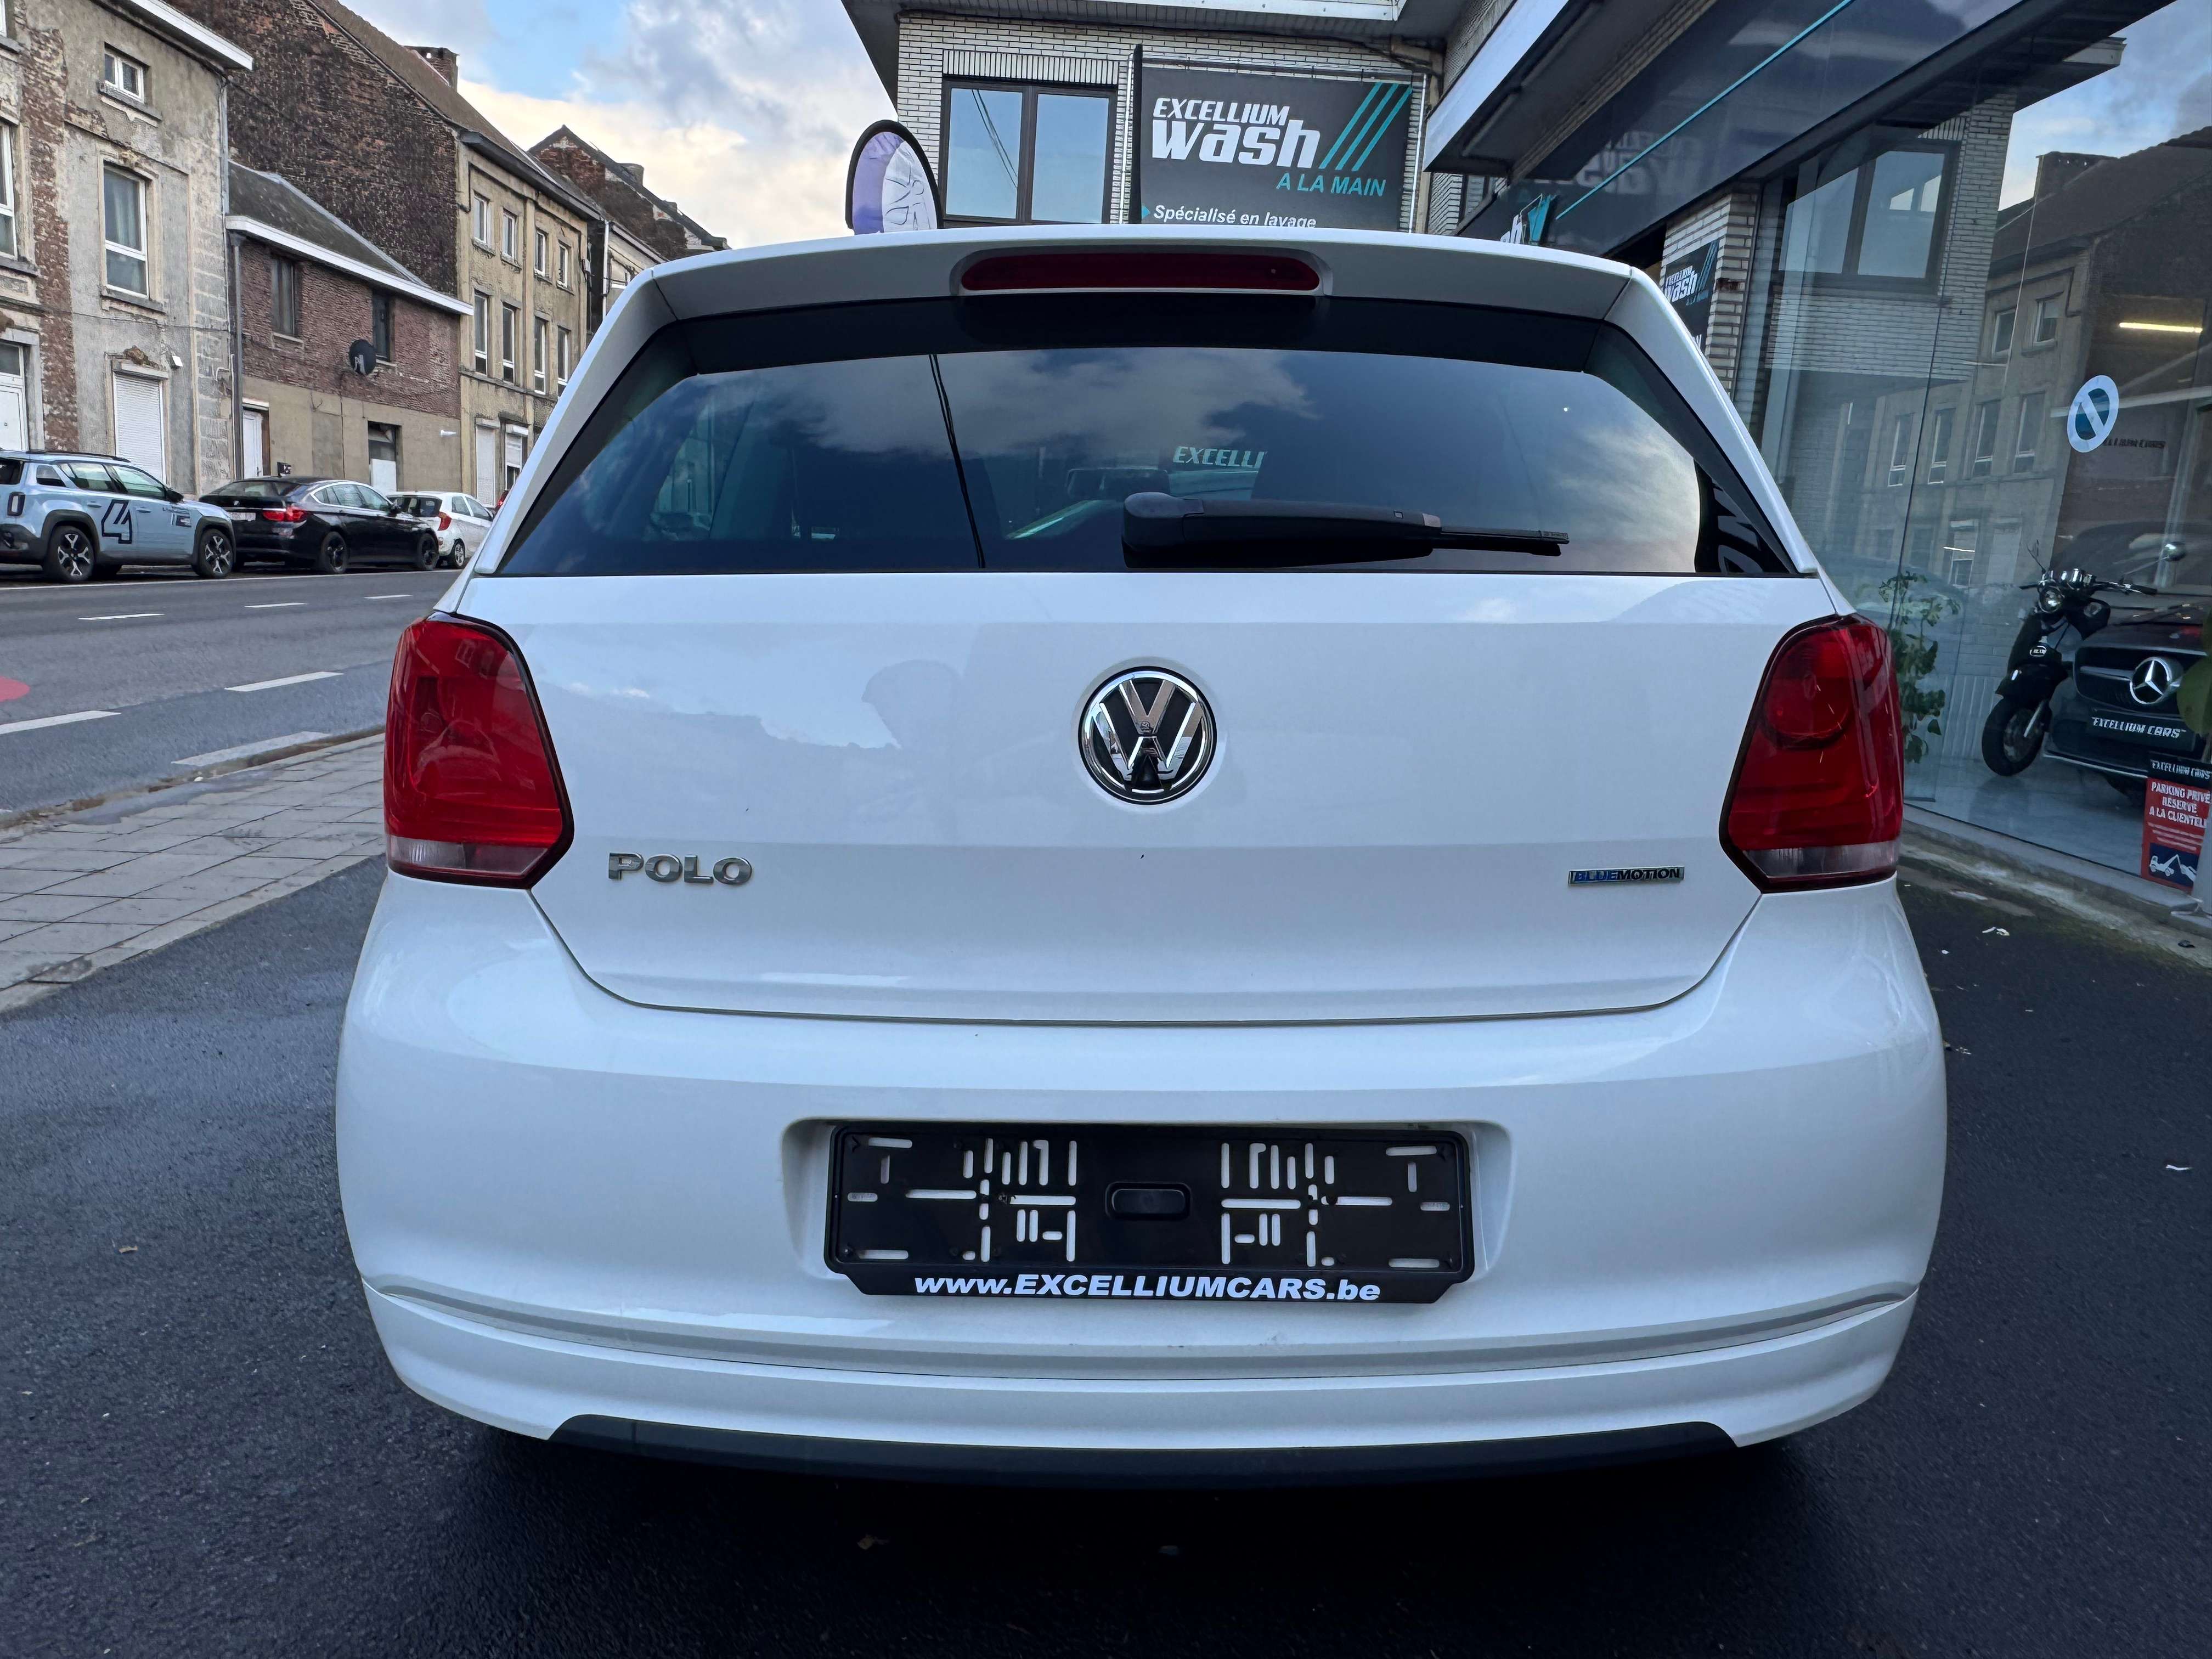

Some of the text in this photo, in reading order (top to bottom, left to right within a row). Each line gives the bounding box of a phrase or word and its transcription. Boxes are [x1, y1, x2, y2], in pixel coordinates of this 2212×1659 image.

[1153, 98, 1290, 126] EXCELLIUM
[1152, 119, 1321, 168] wash
[1276, 172, 1386, 197] A LA MAIN
[1154, 204, 1317, 228] Spécialisé en lavage
[1173, 445, 1268, 469] EXCELLI
[2092, 717, 2146, 733] EXCELLIUM
[2151, 781, 2186, 798] PARKING
[2156, 808, 2166, 819] LA
[608, 851, 753, 885] POLO
[1573, 868, 1680, 882] BLUEMOTION
[914, 1273, 1381, 1301] www.EXCELLIUMCARS.be
